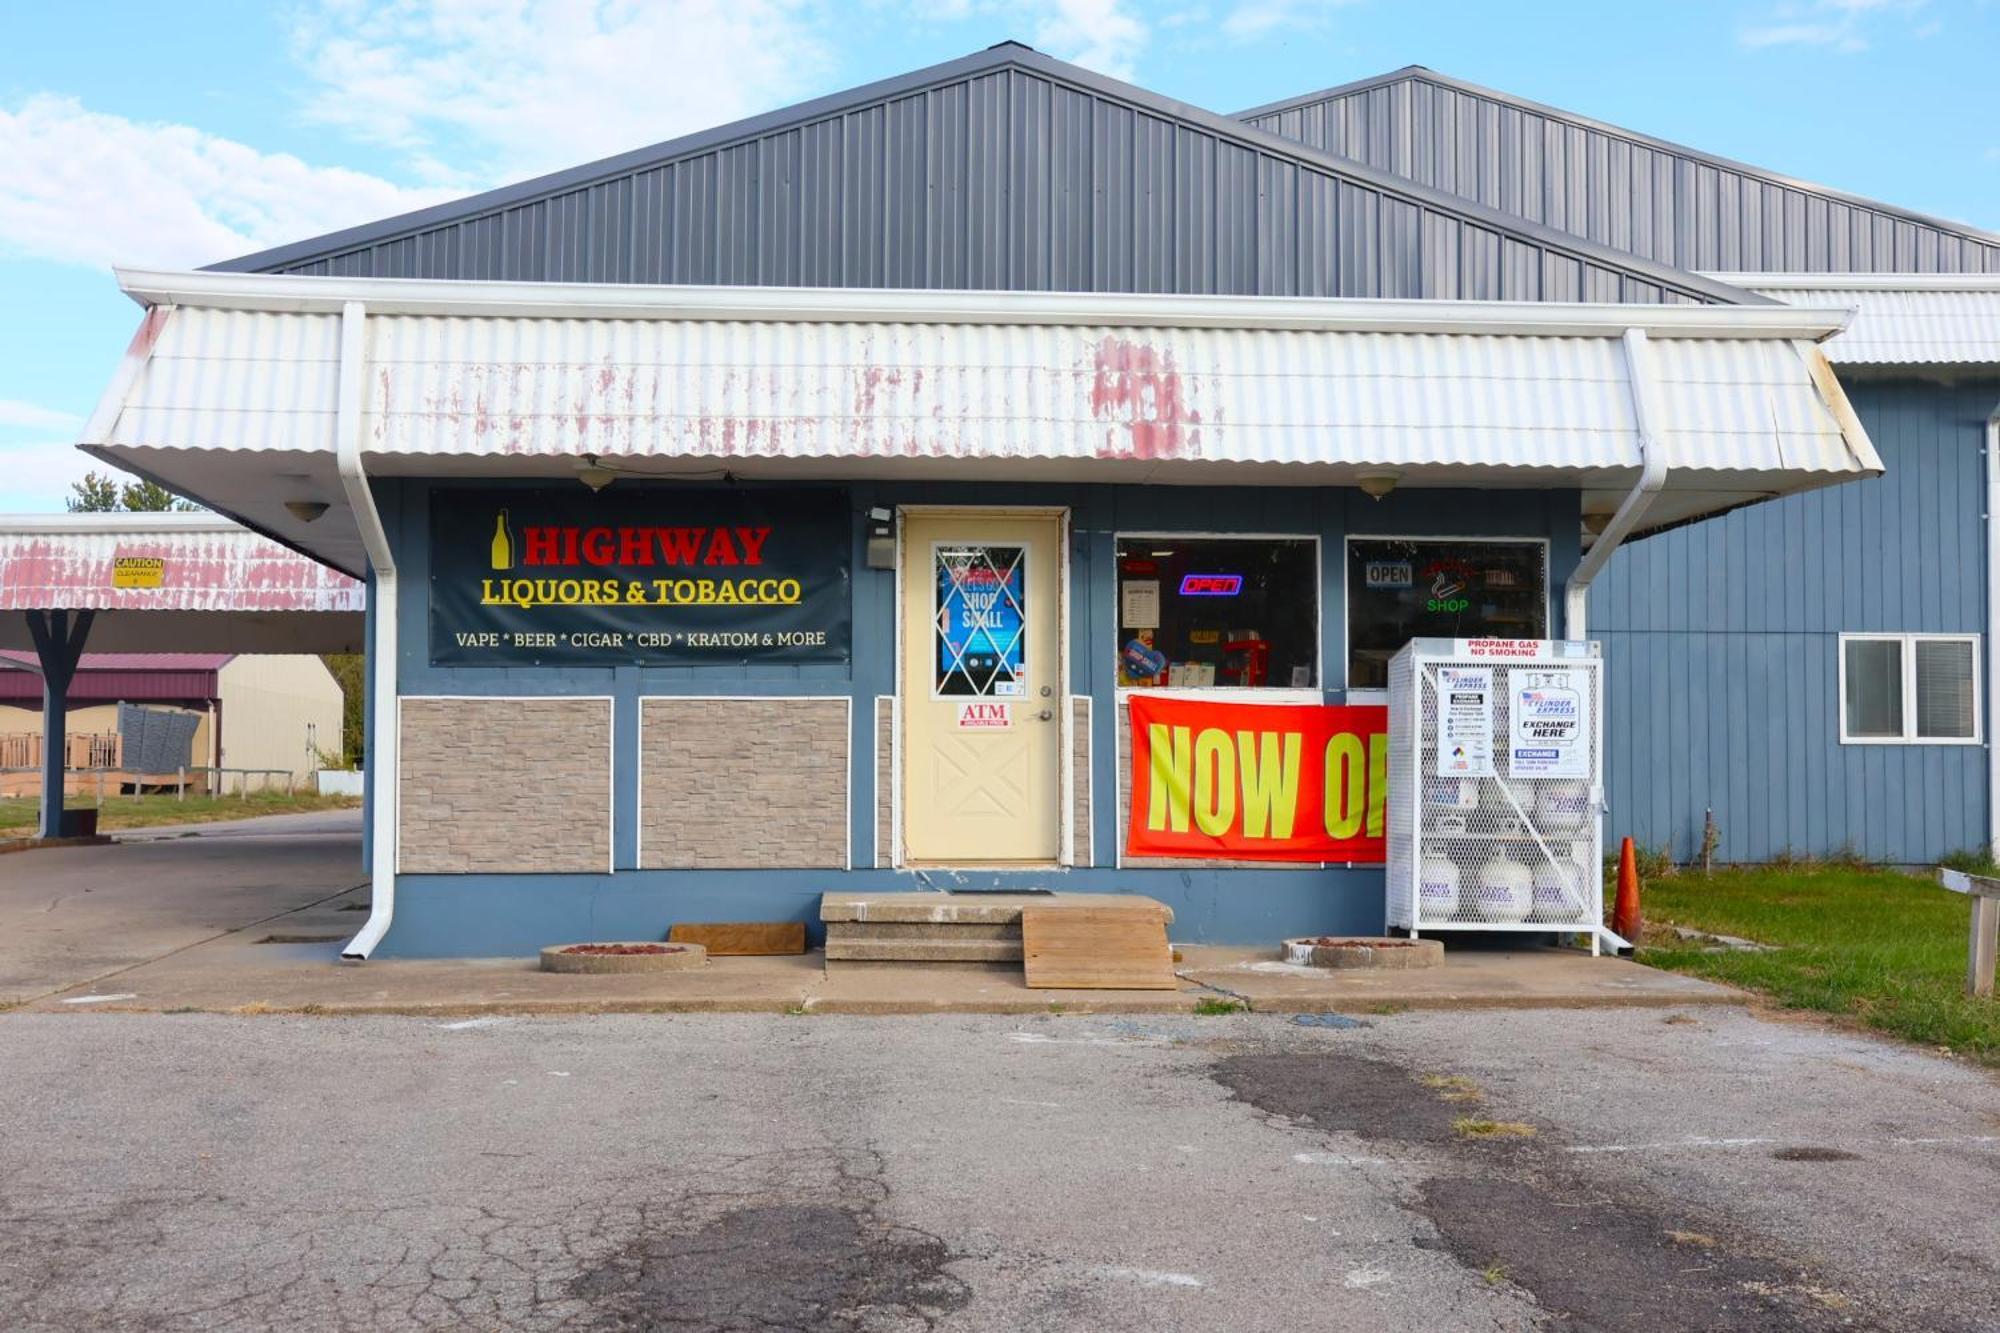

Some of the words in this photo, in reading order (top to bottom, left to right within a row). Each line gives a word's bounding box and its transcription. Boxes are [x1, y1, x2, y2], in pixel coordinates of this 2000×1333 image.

[523, 526, 772, 567] HIGHWAY
[115, 559, 162, 568] CAUTION
[1371, 566, 1409, 582] OPEN
[1184, 578, 1238, 593] OPEN
[481, 578, 619, 610] LIQUORS
[626, 582, 646, 604] &
[652, 578, 801, 604] TOBACCO
[962, 592, 997, 610] SHOP
[1427, 599, 1470, 613] SHOP
[962, 611, 1004, 629] SMALL
[456, 633, 500, 648] VAPE
[514, 633, 557, 648] BEER
[571, 633, 623, 648] CIGAR
[638, 633, 673, 648] CBD
[687, 632, 758, 647] KRATOM
[762, 632, 774, 646] &
[777, 631, 827, 646] MORE
[1467, 640, 1514, 648] PROPANE
[1518, 640, 1539, 649] GAS
[1470, 648, 1485, 656] NO
[1489, 648, 1537, 657] SMOKING
[963, 704, 1006, 719] ATM
[1523, 720, 1577, 729] EXCHANGE
[1532, 729, 1567, 738] HERE
[1518, 750, 1558, 758] EXCHANGE
[1148, 723, 1303, 839] NOW
